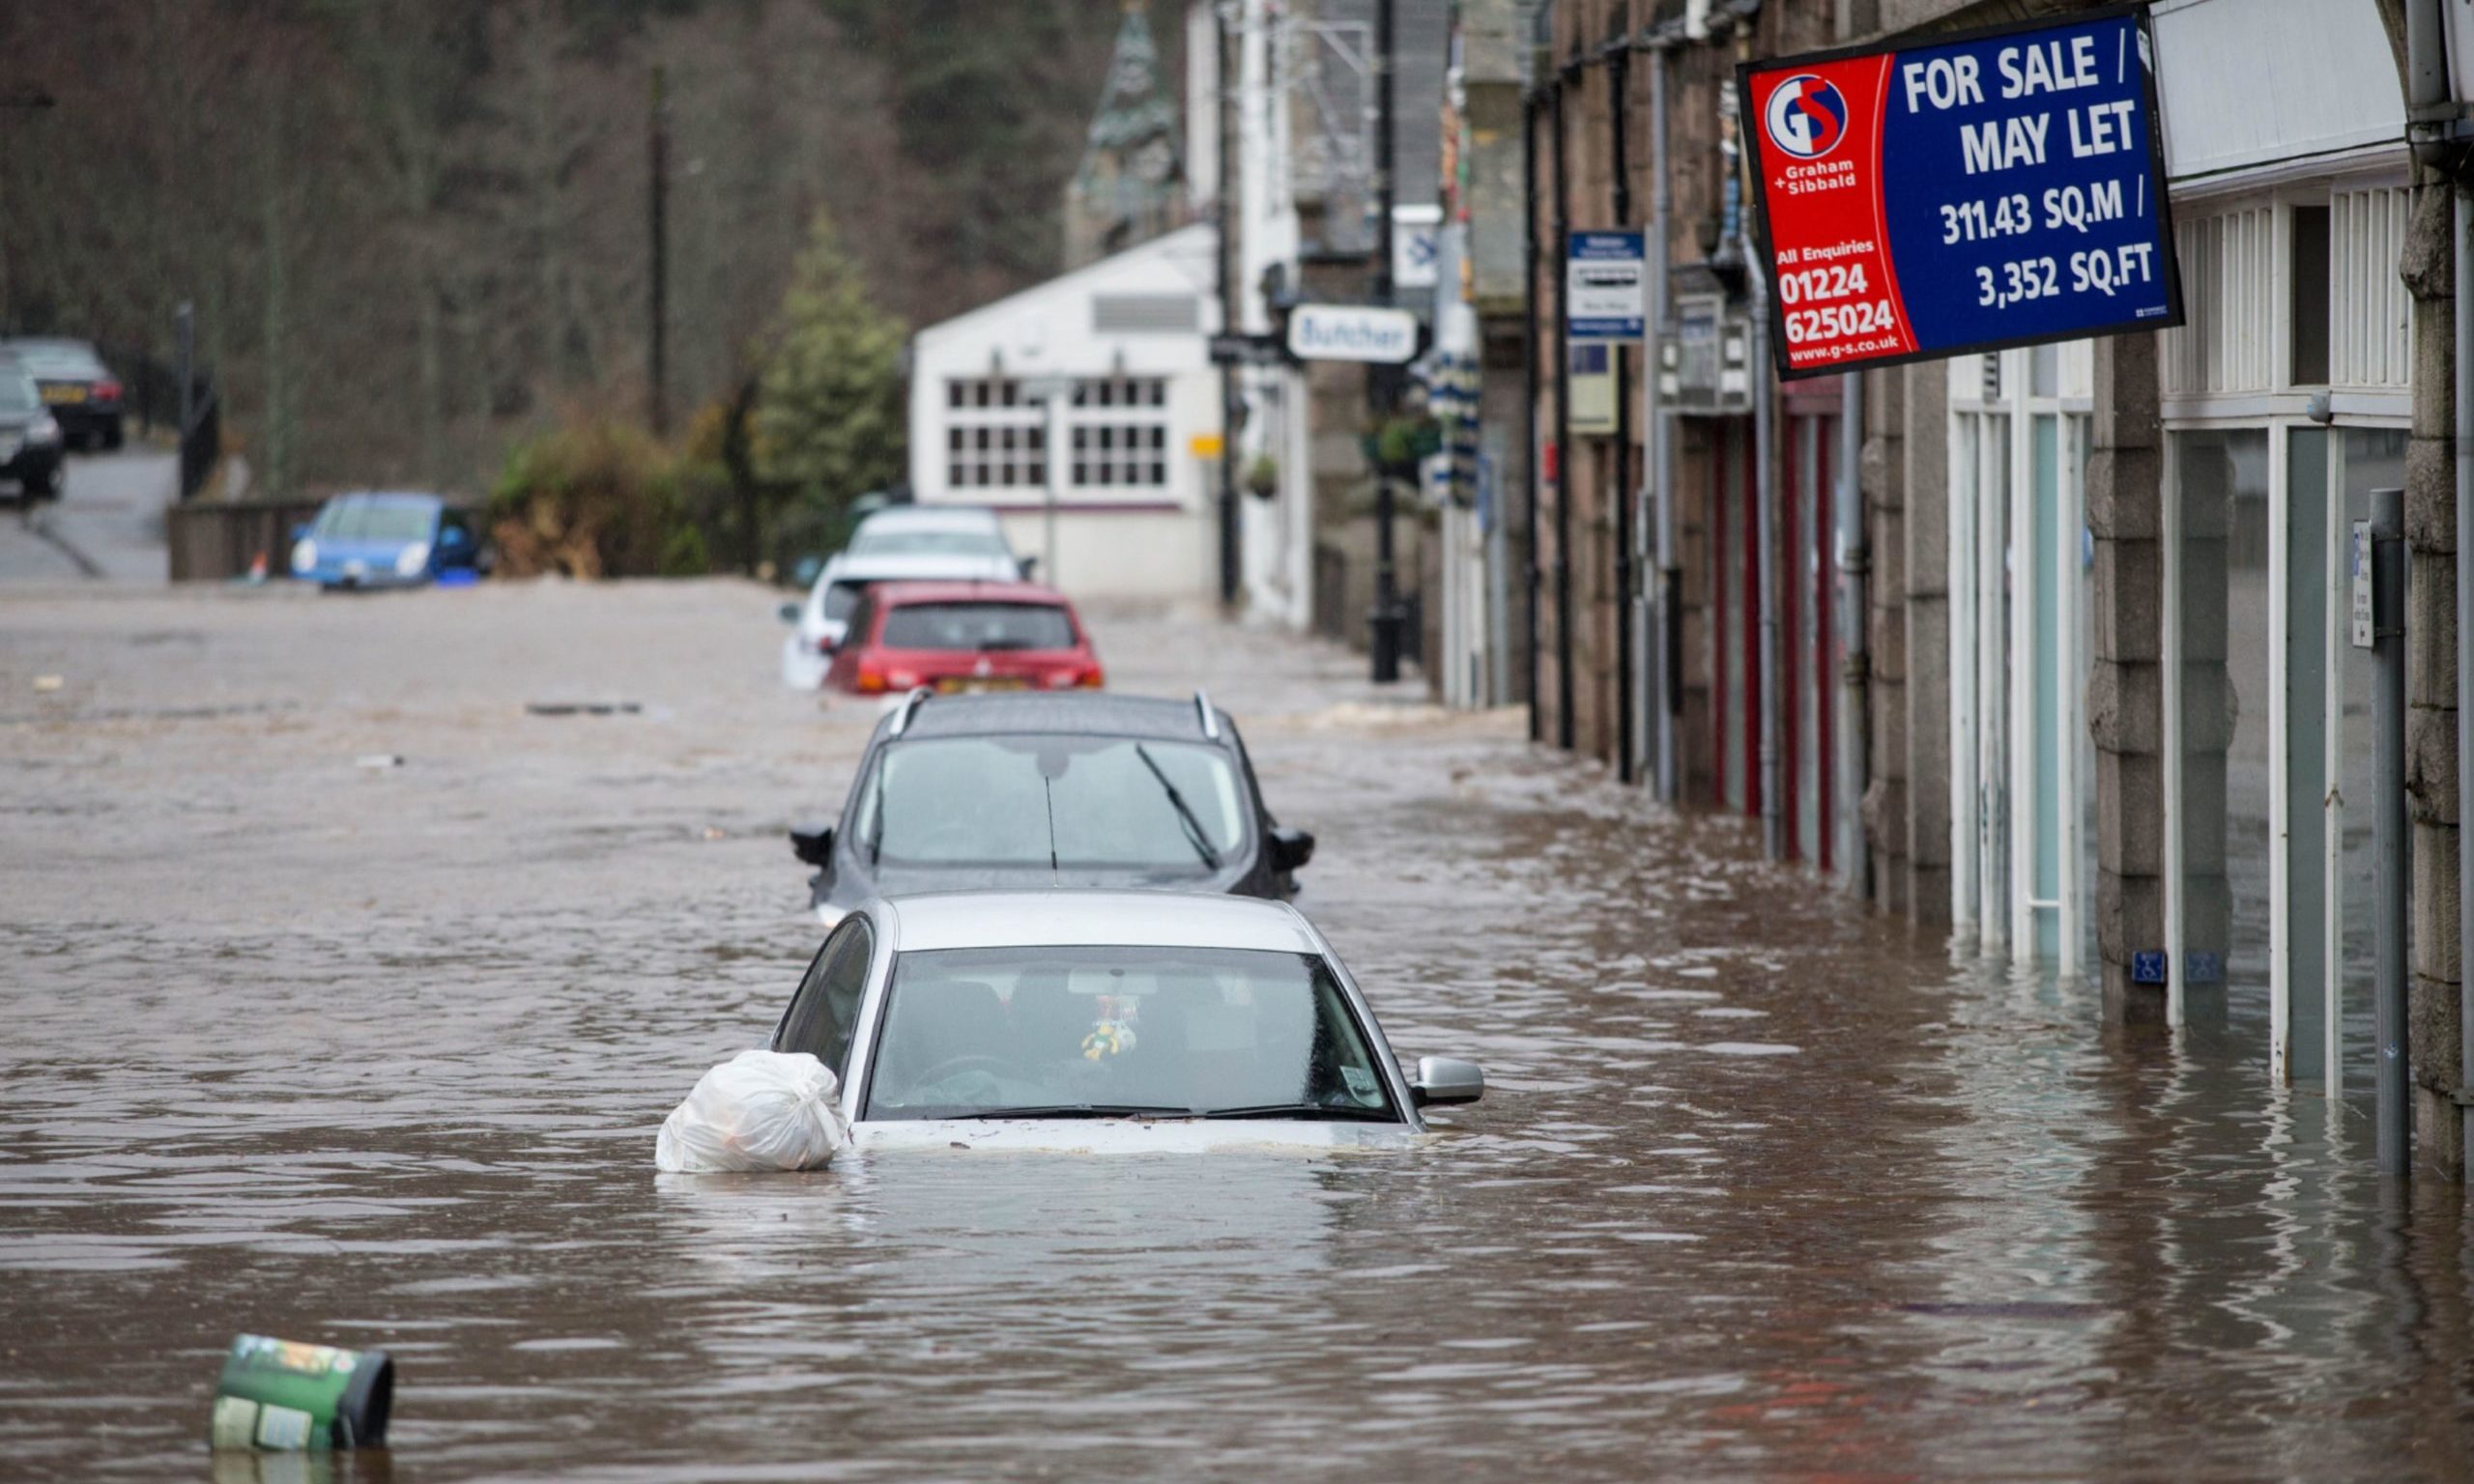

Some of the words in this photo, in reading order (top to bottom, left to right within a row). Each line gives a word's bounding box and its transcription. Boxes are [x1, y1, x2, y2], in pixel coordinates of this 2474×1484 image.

[1902, 54, 1984, 114] FOR
[1998, 36, 2099, 99] SALE
[1960, 112, 2050, 175] MAY
[2067, 100, 2135, 158] LET
[1785, 159, 1854, 180] Graham
[1940, 193, 2032, 244] 311.43
[2044, 179, 2123, 232] SQ.M
[1776, 248, 1798, 265] All
[1802, 239, 1875, 261] Enquiries
[1779, 263, 1868, 304] 01224
[1975, 256, 2060, 309] 3,352
[2070, 242, 2153, 296] SQ.FT
[1302, 316, 1403, 349] Butcher
[1785, 299, 1895, 344] 625024
[1790, 335, 1898, 361] www.g-s.co.uk
